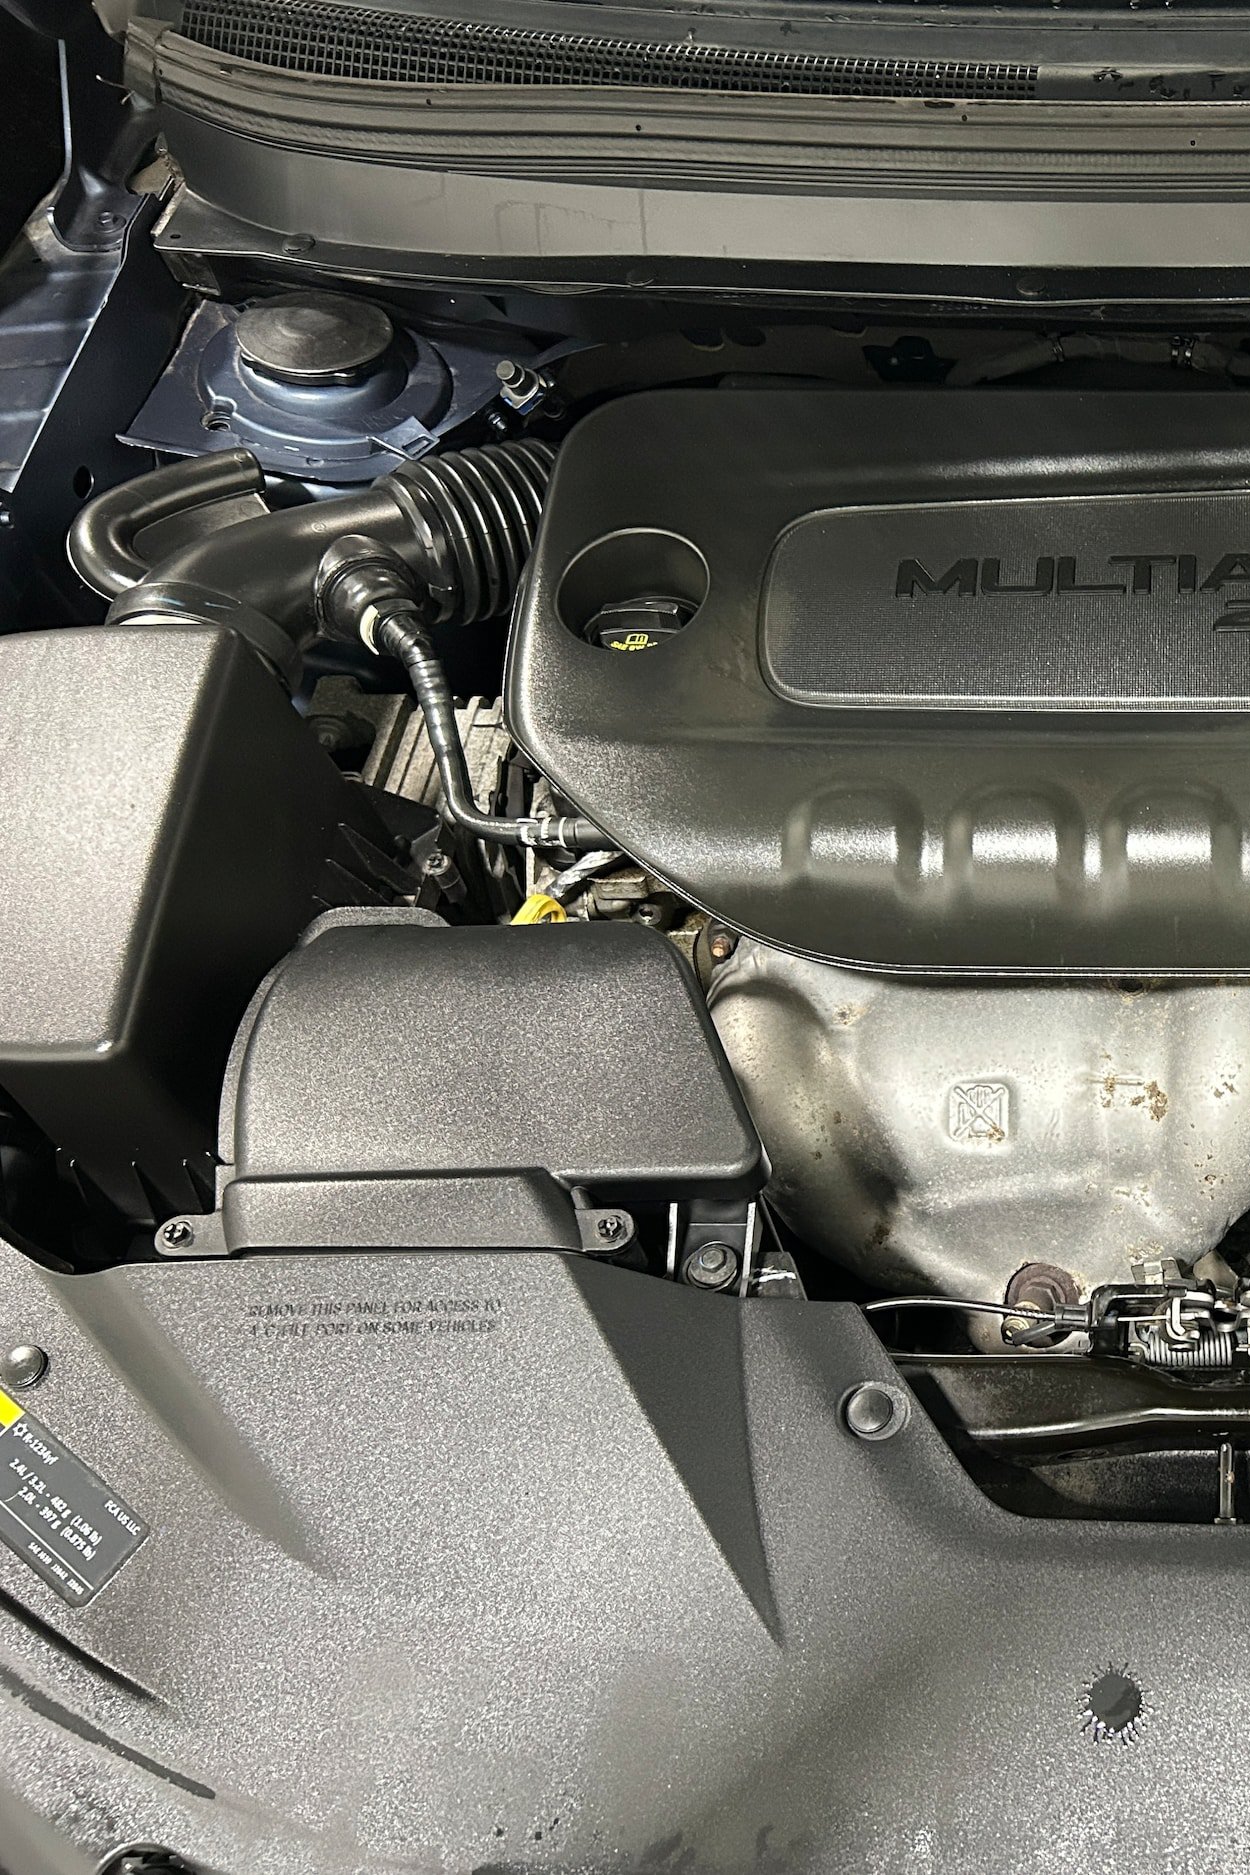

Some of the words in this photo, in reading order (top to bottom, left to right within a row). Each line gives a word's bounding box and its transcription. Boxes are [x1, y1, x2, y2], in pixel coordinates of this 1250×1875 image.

[22, 1432, 59, 1466] R-1234yf
[9, 1458, 26, 1480] 2.4L
[27, 1474, 47, 1496] 3.2L
[51, 1495, 67, 1514] 482
[70, 1514, 93, 1538] (1.06
[87, 1528, 103, 1547] lb)
[18, 1486, 37, 1506] 2.0L
[39, 1505, 57, 1525] 397
[60, 1524, 86, 1553] (0.875
[81, 1544, 97, 1561] lb)
[104, 1499, 121, 1519] FCA
[116, 1511, 131, 1529] US
[125, 1520, 142, 1536] LLC
